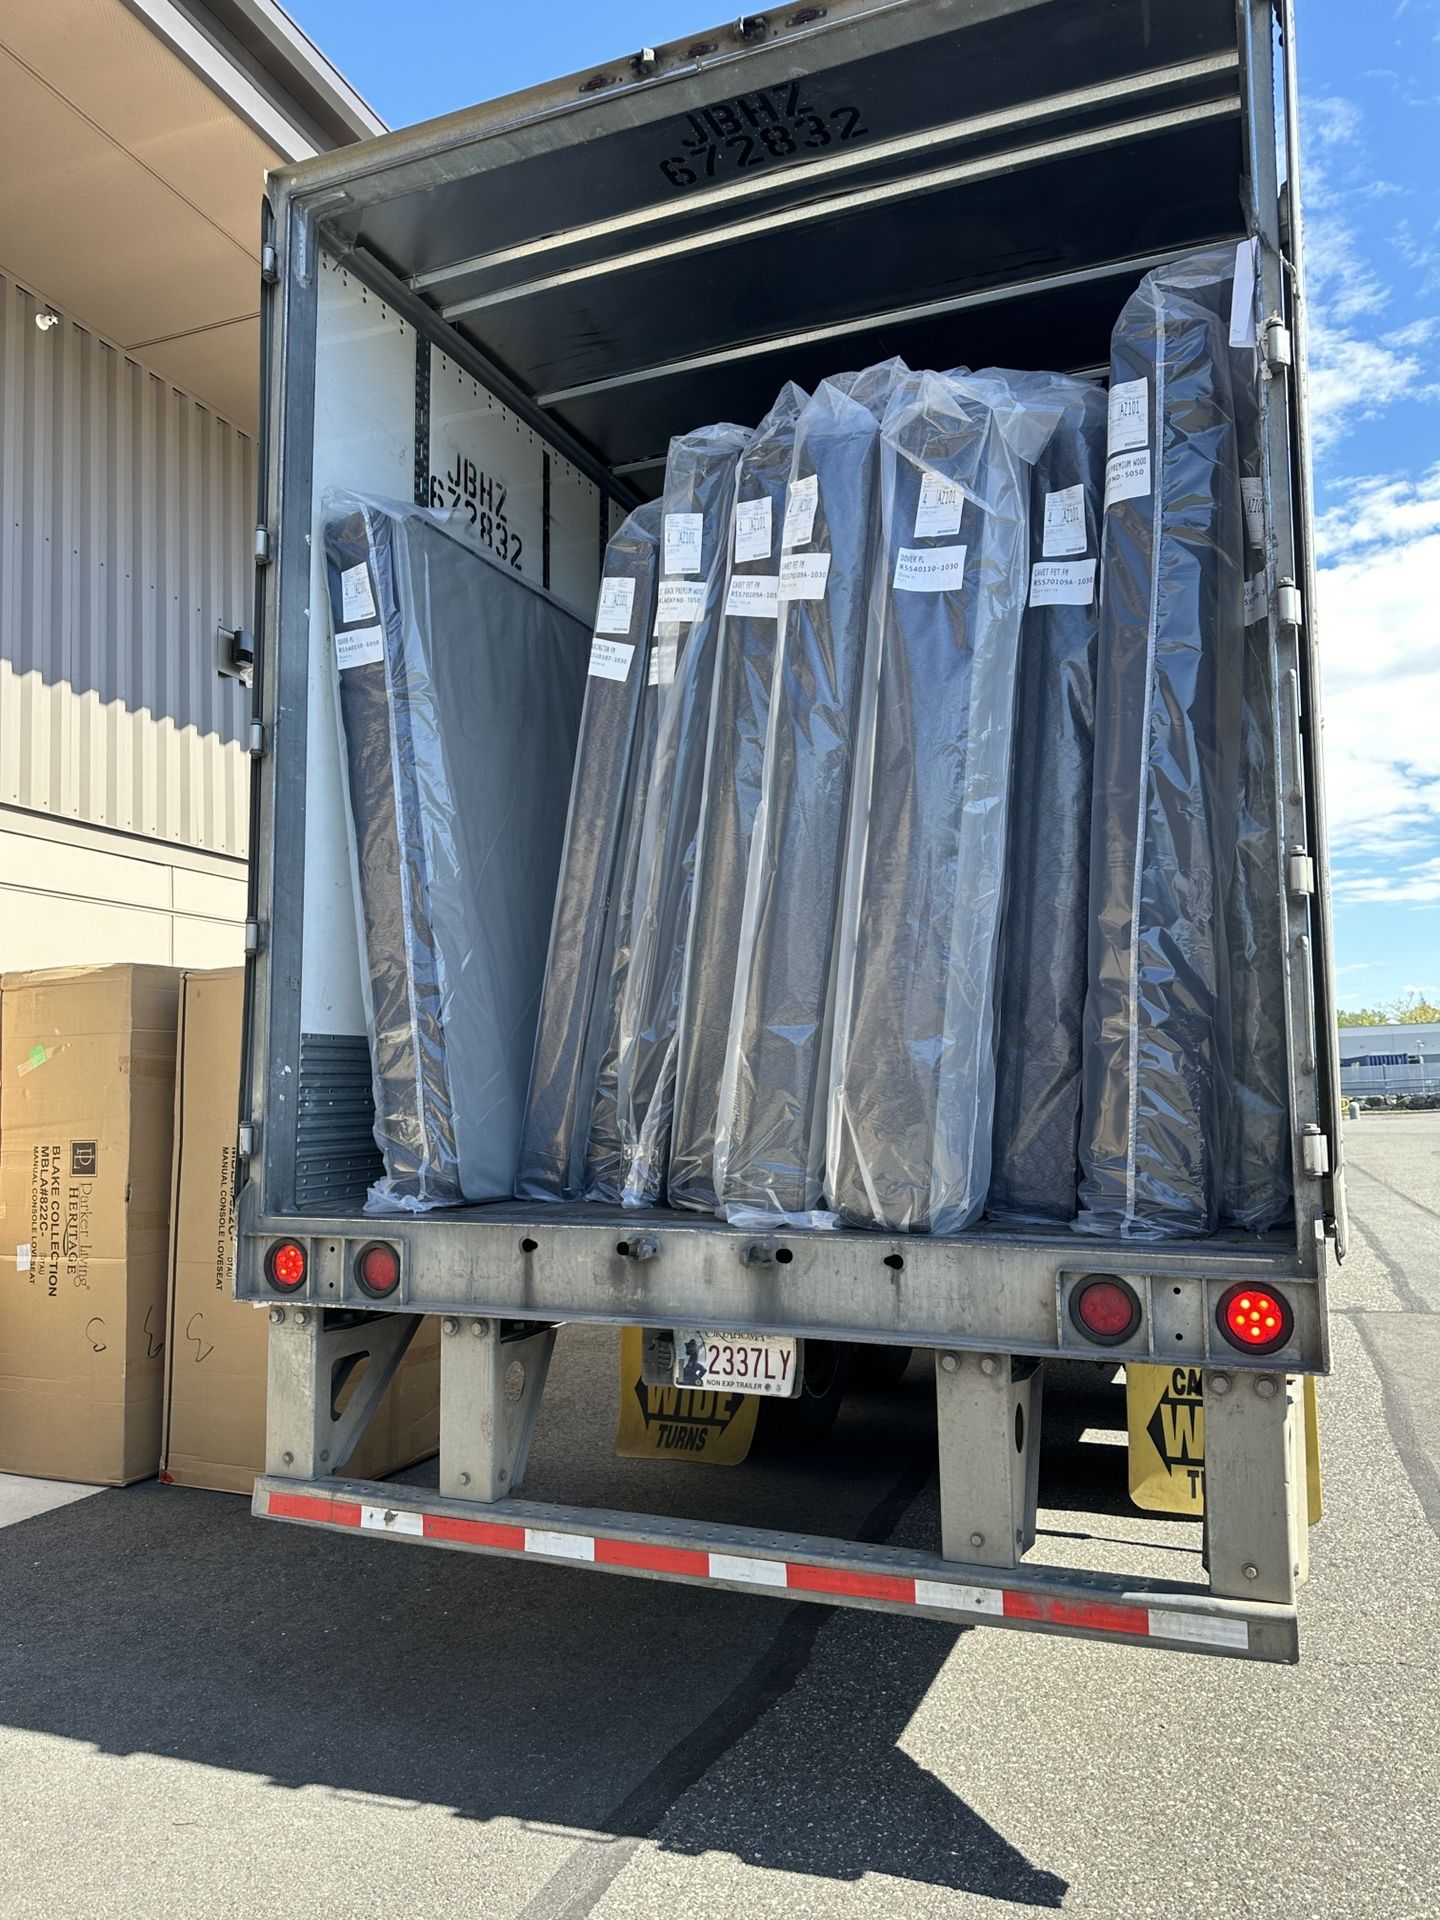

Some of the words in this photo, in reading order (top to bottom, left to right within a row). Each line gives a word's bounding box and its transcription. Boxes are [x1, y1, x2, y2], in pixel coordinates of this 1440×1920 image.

[681, 81, 814, 147] JBHZ
[659, 106, 869, 187] 672832
[447, 452, 507, 523] JBHZ
[31, 1146, 39, 1185] MANUAL
[51, 1146, 61, 1197] BLAKE
[221, 1146, 229, 1187] MANUAL
[31, 1188, 39, 1233] CONSOLE
[39, 1146, 50, 1237] MBLA#822C-
[80, 1182, 93, 1237] Parker
[218, 1190, 227, 1237] CONSOLE
[48, 1201, 61, 1297] COLLECTION
[66, 1187, 79, 1275] HERITAGE
[216, 1240, 225, 1291] LOVESEAT
[708, 1344, 791, 1380] 2337LY
[736, 1381, 762, 1390] TRAILER
[647, 1386, 733, 1421] WIDE
[656, 1424, 709, 1451] TURNS
